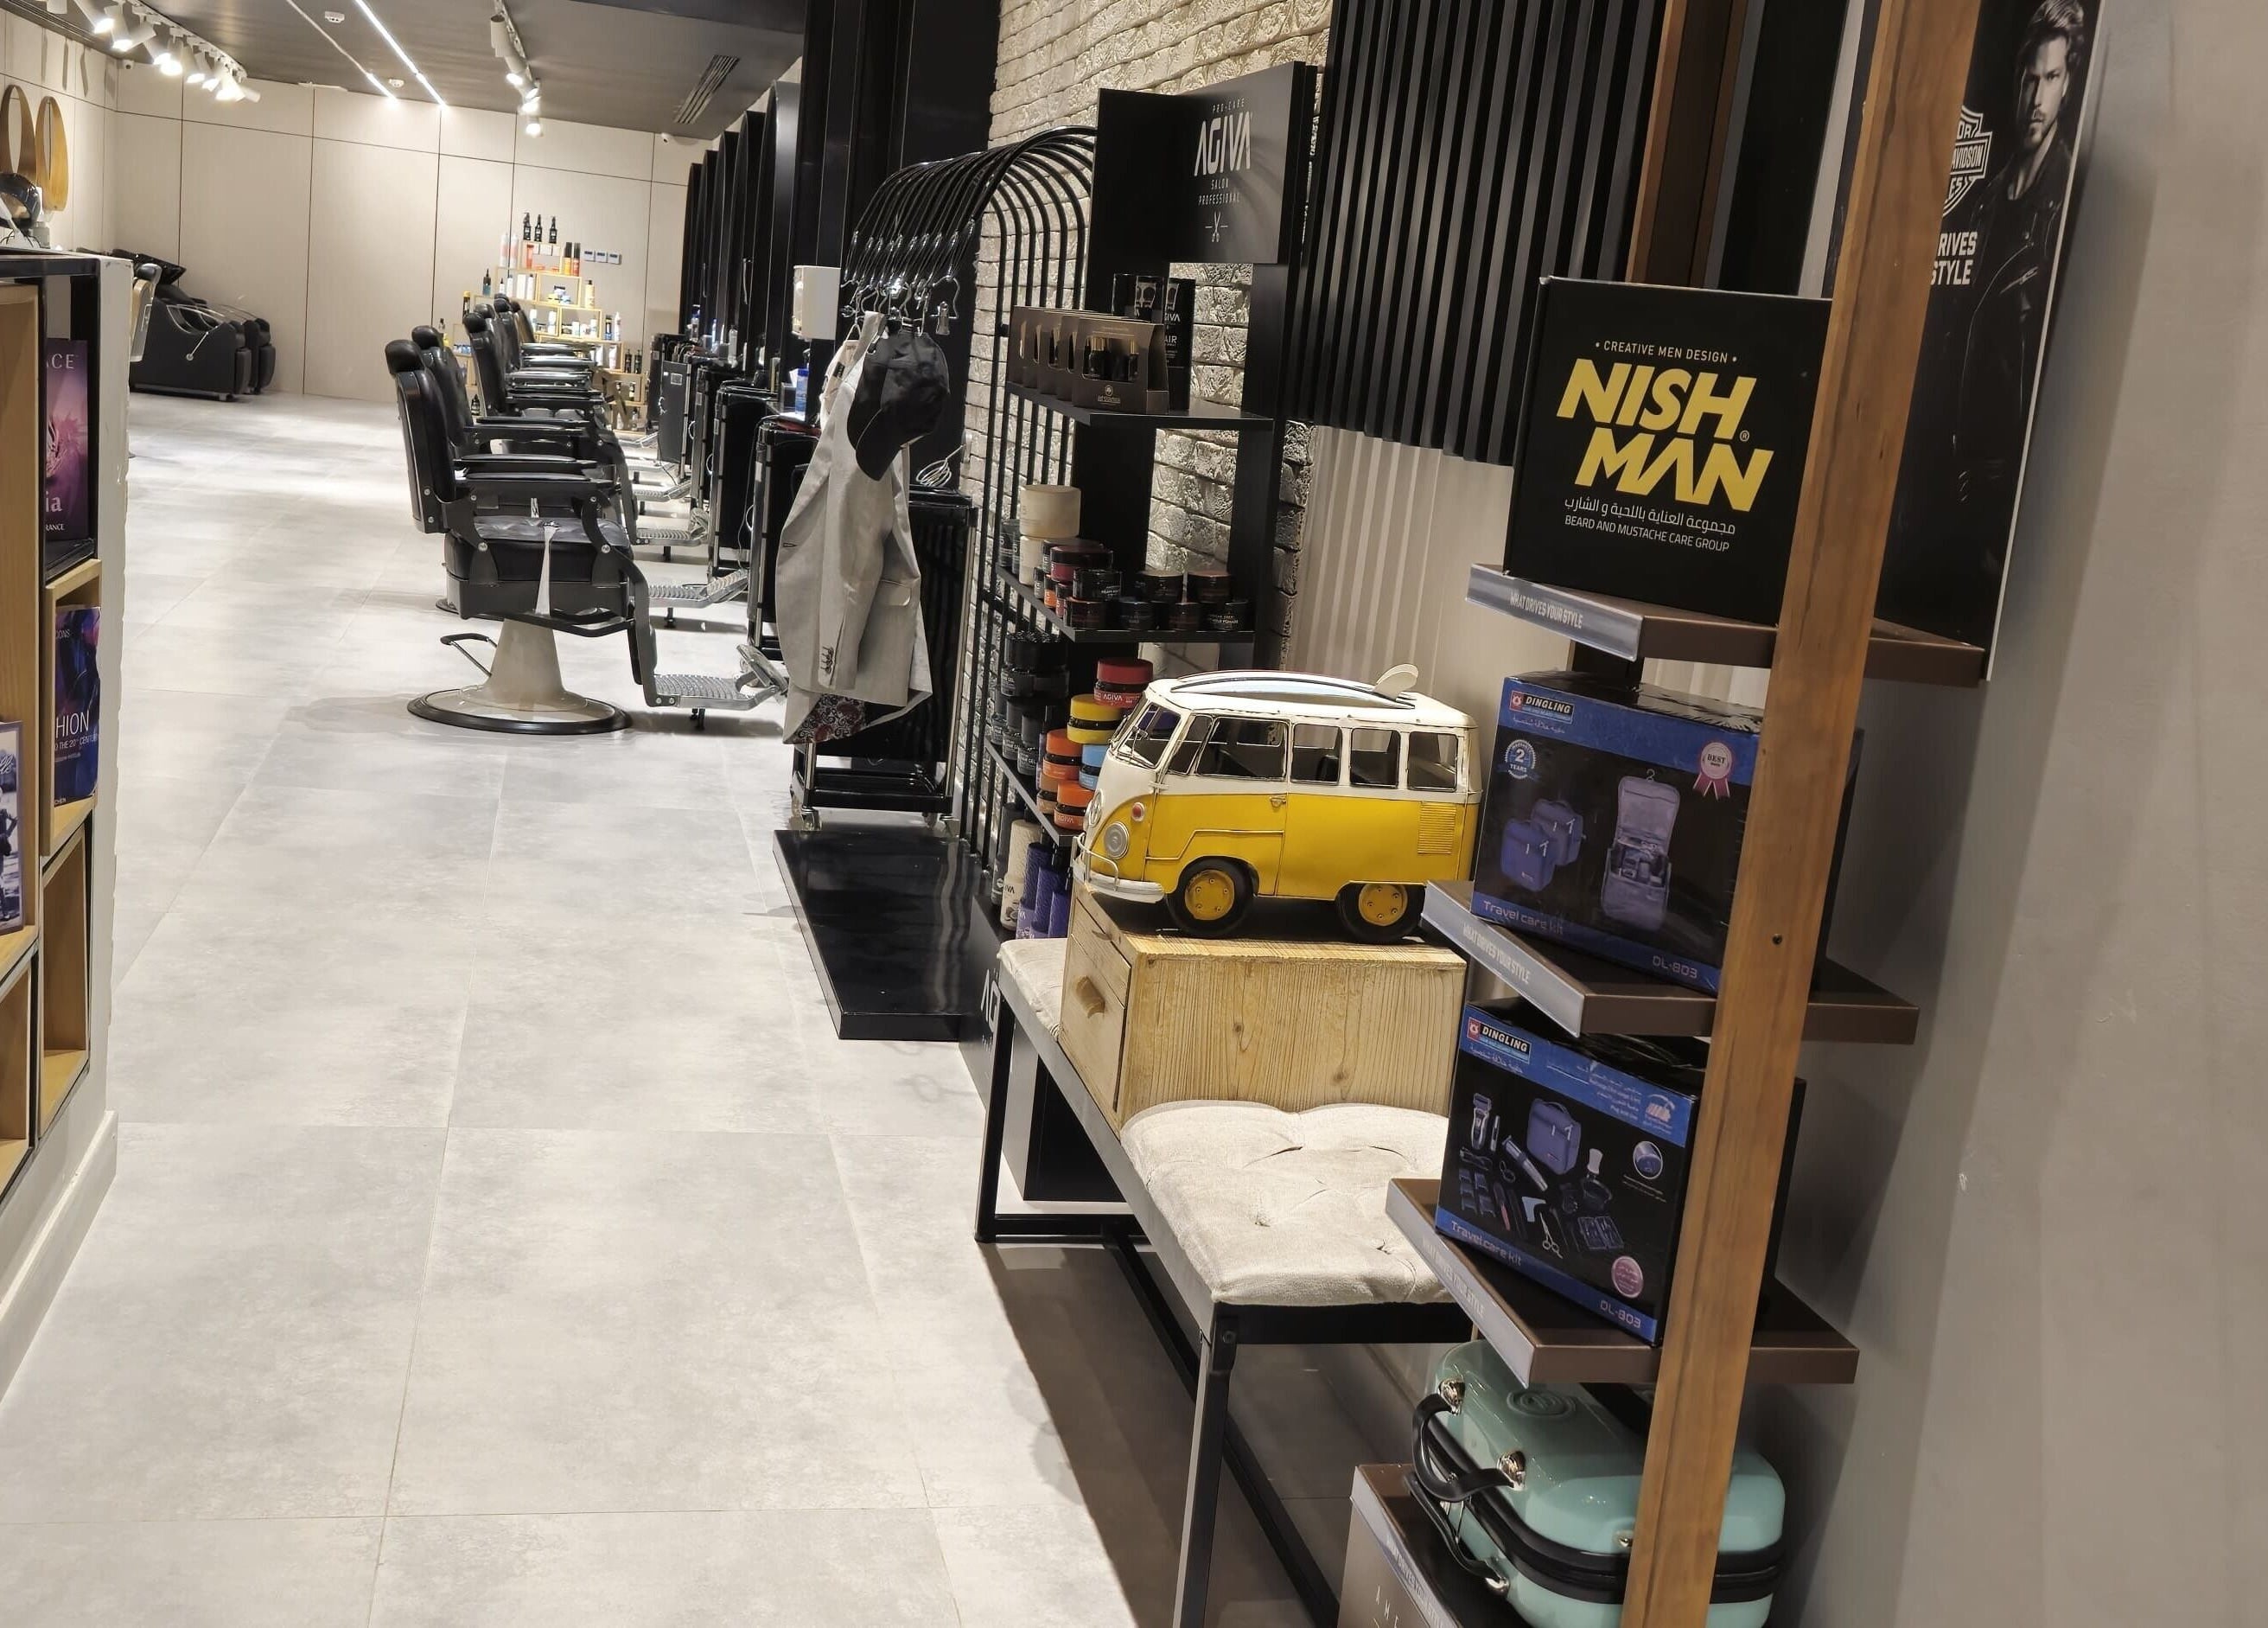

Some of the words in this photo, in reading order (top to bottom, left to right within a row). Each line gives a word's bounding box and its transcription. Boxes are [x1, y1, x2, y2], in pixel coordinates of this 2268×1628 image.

[1194, 112, 1252, 177] AGIVA
[1951, 145, 1984, 169] AVIDSON
[1210, 177, 1230, 190] SALON
[1938, 232, 1978, 257] RIVES
[46, 353, 75, 369] CE
[1603, 340, 1654, 357] CREATIVE
[1658, 346, 1682, 359] MEN
[1685, 349, 1729, 363] DESIGN
[1556, 358, 1757, 440] NISH
[1574, 428, 1774, 512] MAN
[45, 490, 63, 513] ia
[1564, 495, 1600, 513] الشارب
[1601, 503, 1609, 517] و
[1610, 502, 1646, 522] باللحية
[1647, 508, 1685, 527] العناية
[1685, 514, 1736, 535] مجموعة
[1564, 514, 1596, 529] BEARD
[1596, 519, 1616, 533] AND
[1617, 523, 1668, 542] MUSTACHE
[1668, 533, 1693, 546] CARE
[1695, 537, 1730, 552] GROUP
[1526, 597, 1547, 616] DRIVES
[1546, 603, 1564, 622] YOUR
[1563, 609, 1583, 629] STYLE
[1103, 693, 1123, 702] AGIVA
[1526, 695, 1571, 714] DINGLING
[1515, 748, 1525, 763] 2
[1707, 753, 1726, 764] BEST
[1483, 900, 1519, 921] Travel
[1520, 915, 1548, 930] care
[1511, 959, 1530, 984] STYLE
[1481, 1026, 1528, 1052] DINGLING
[1451, 1221, 1483, 1247] Travel
[1483, 1240, 1507, 1259] care
